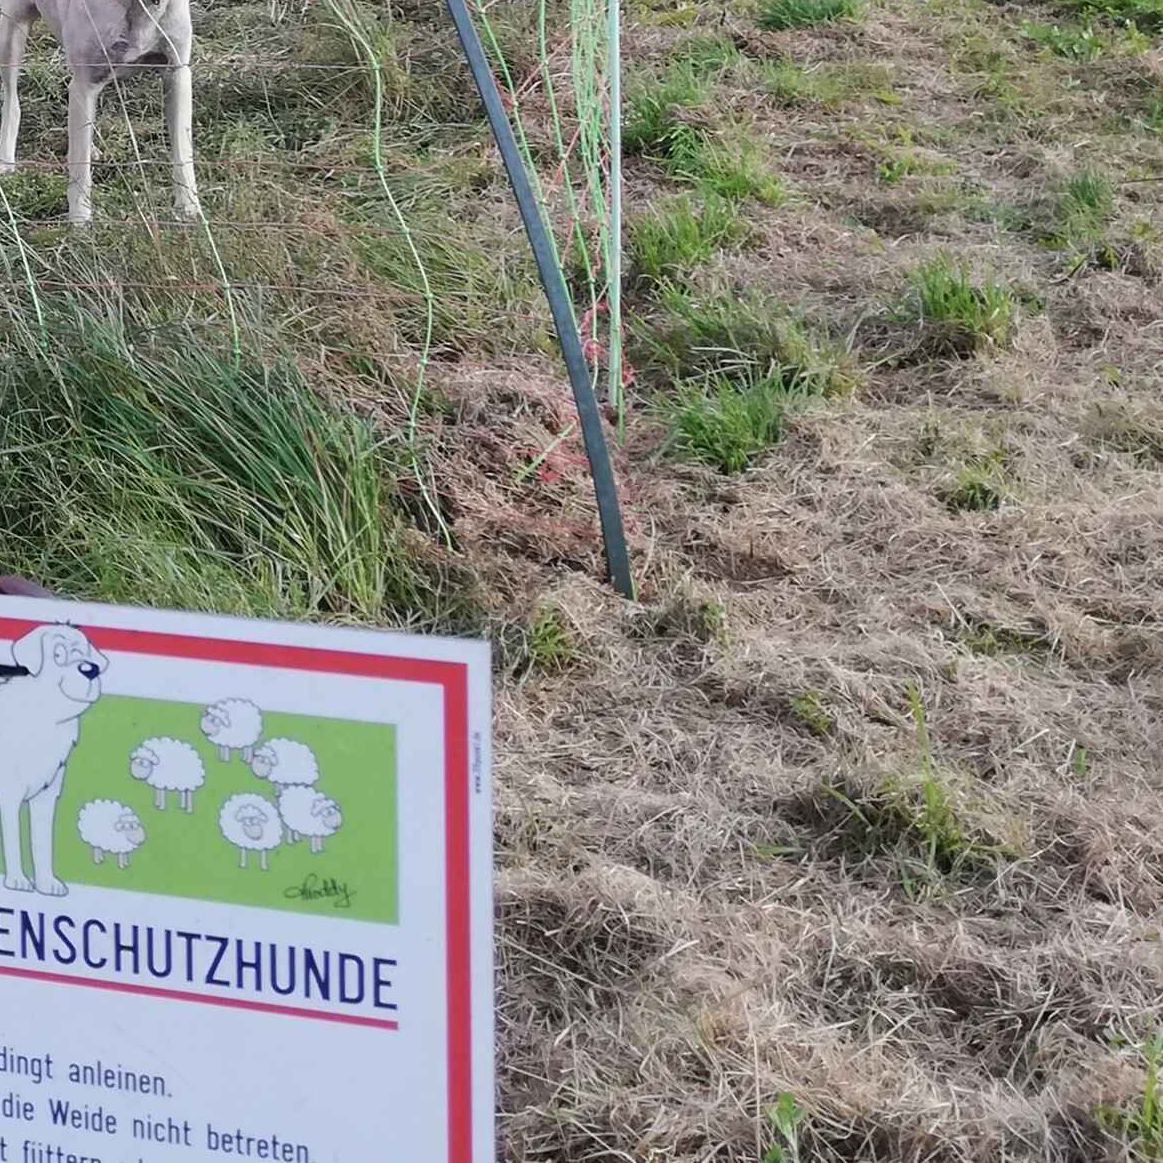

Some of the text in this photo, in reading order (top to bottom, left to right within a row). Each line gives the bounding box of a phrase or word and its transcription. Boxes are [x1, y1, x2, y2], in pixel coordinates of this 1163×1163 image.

[68, 1061, 173, 1098] anleinen.
[2, 1092, 35, 1122] die
[48, 1098, 118, 1135] Weide
[132, 1114, 193, 1148] nicht
